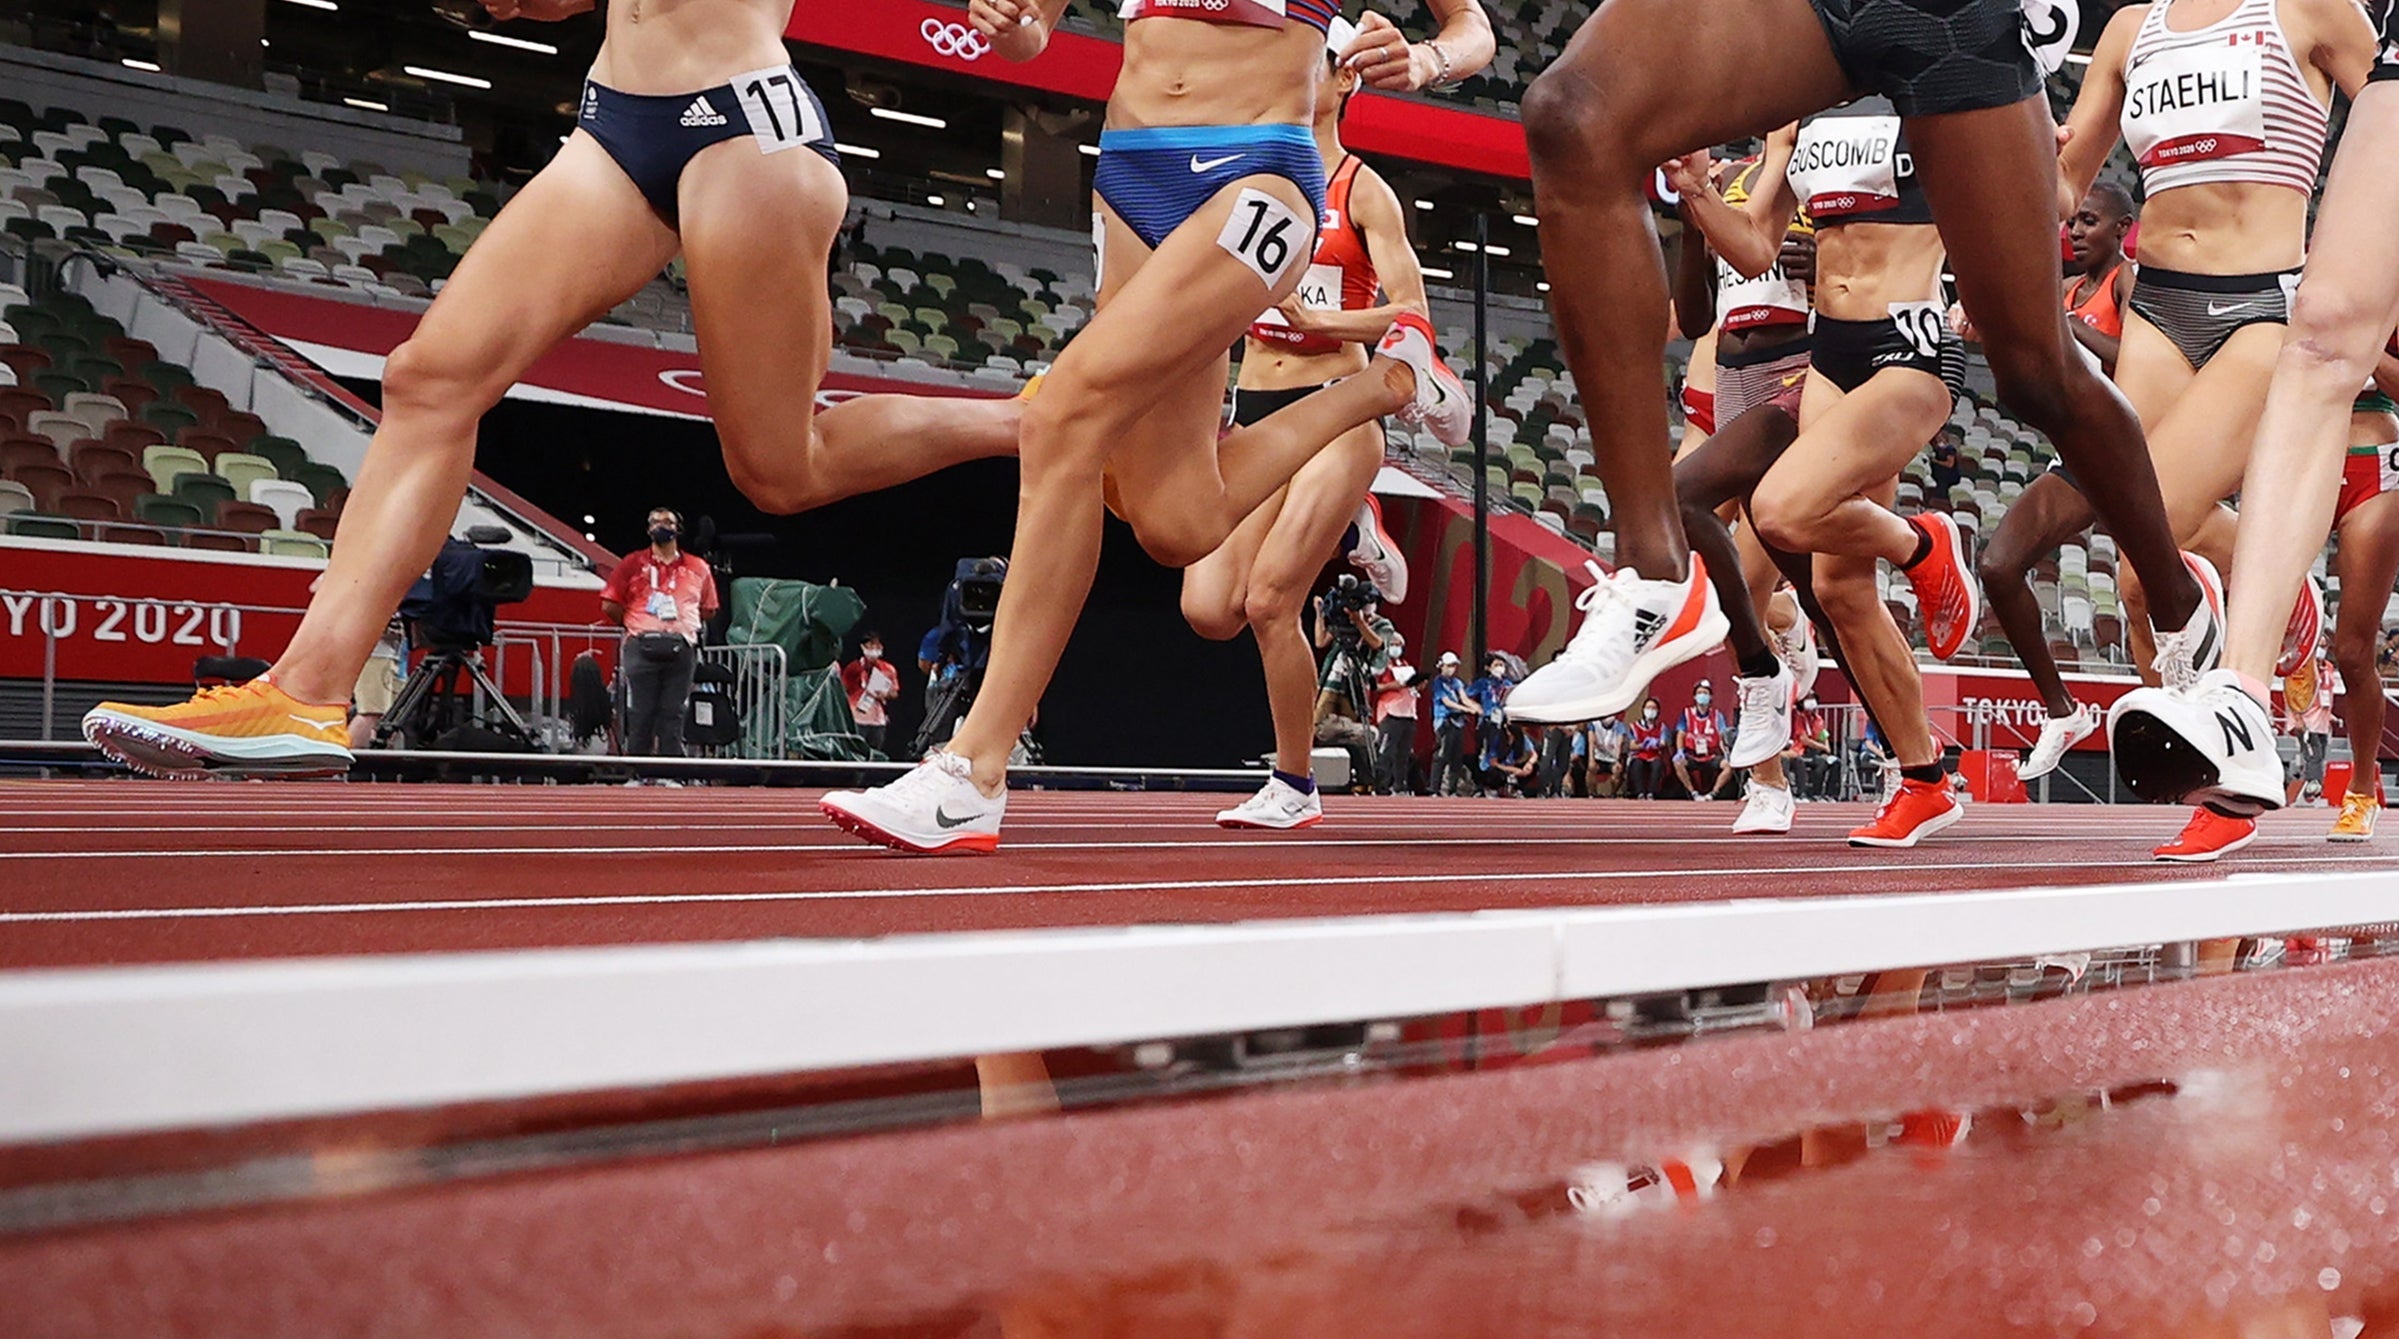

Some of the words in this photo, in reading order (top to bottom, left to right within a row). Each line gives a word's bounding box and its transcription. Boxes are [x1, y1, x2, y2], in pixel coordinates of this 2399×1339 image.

[746, 74, 804, 142] 17
[2129, 70, 2249, 119] STAEHLI
[680, 114, 727, 127] adidas
[1238, 200, 1293, 274] 16
[1301, 286, 1328, 305] KA
[1896, 307, 1942, 351] 10
[0, 589, 77, 638] YO
[93, 595, 242, 647] 2020
[1962, 696, 2042, 727] TOKYO
